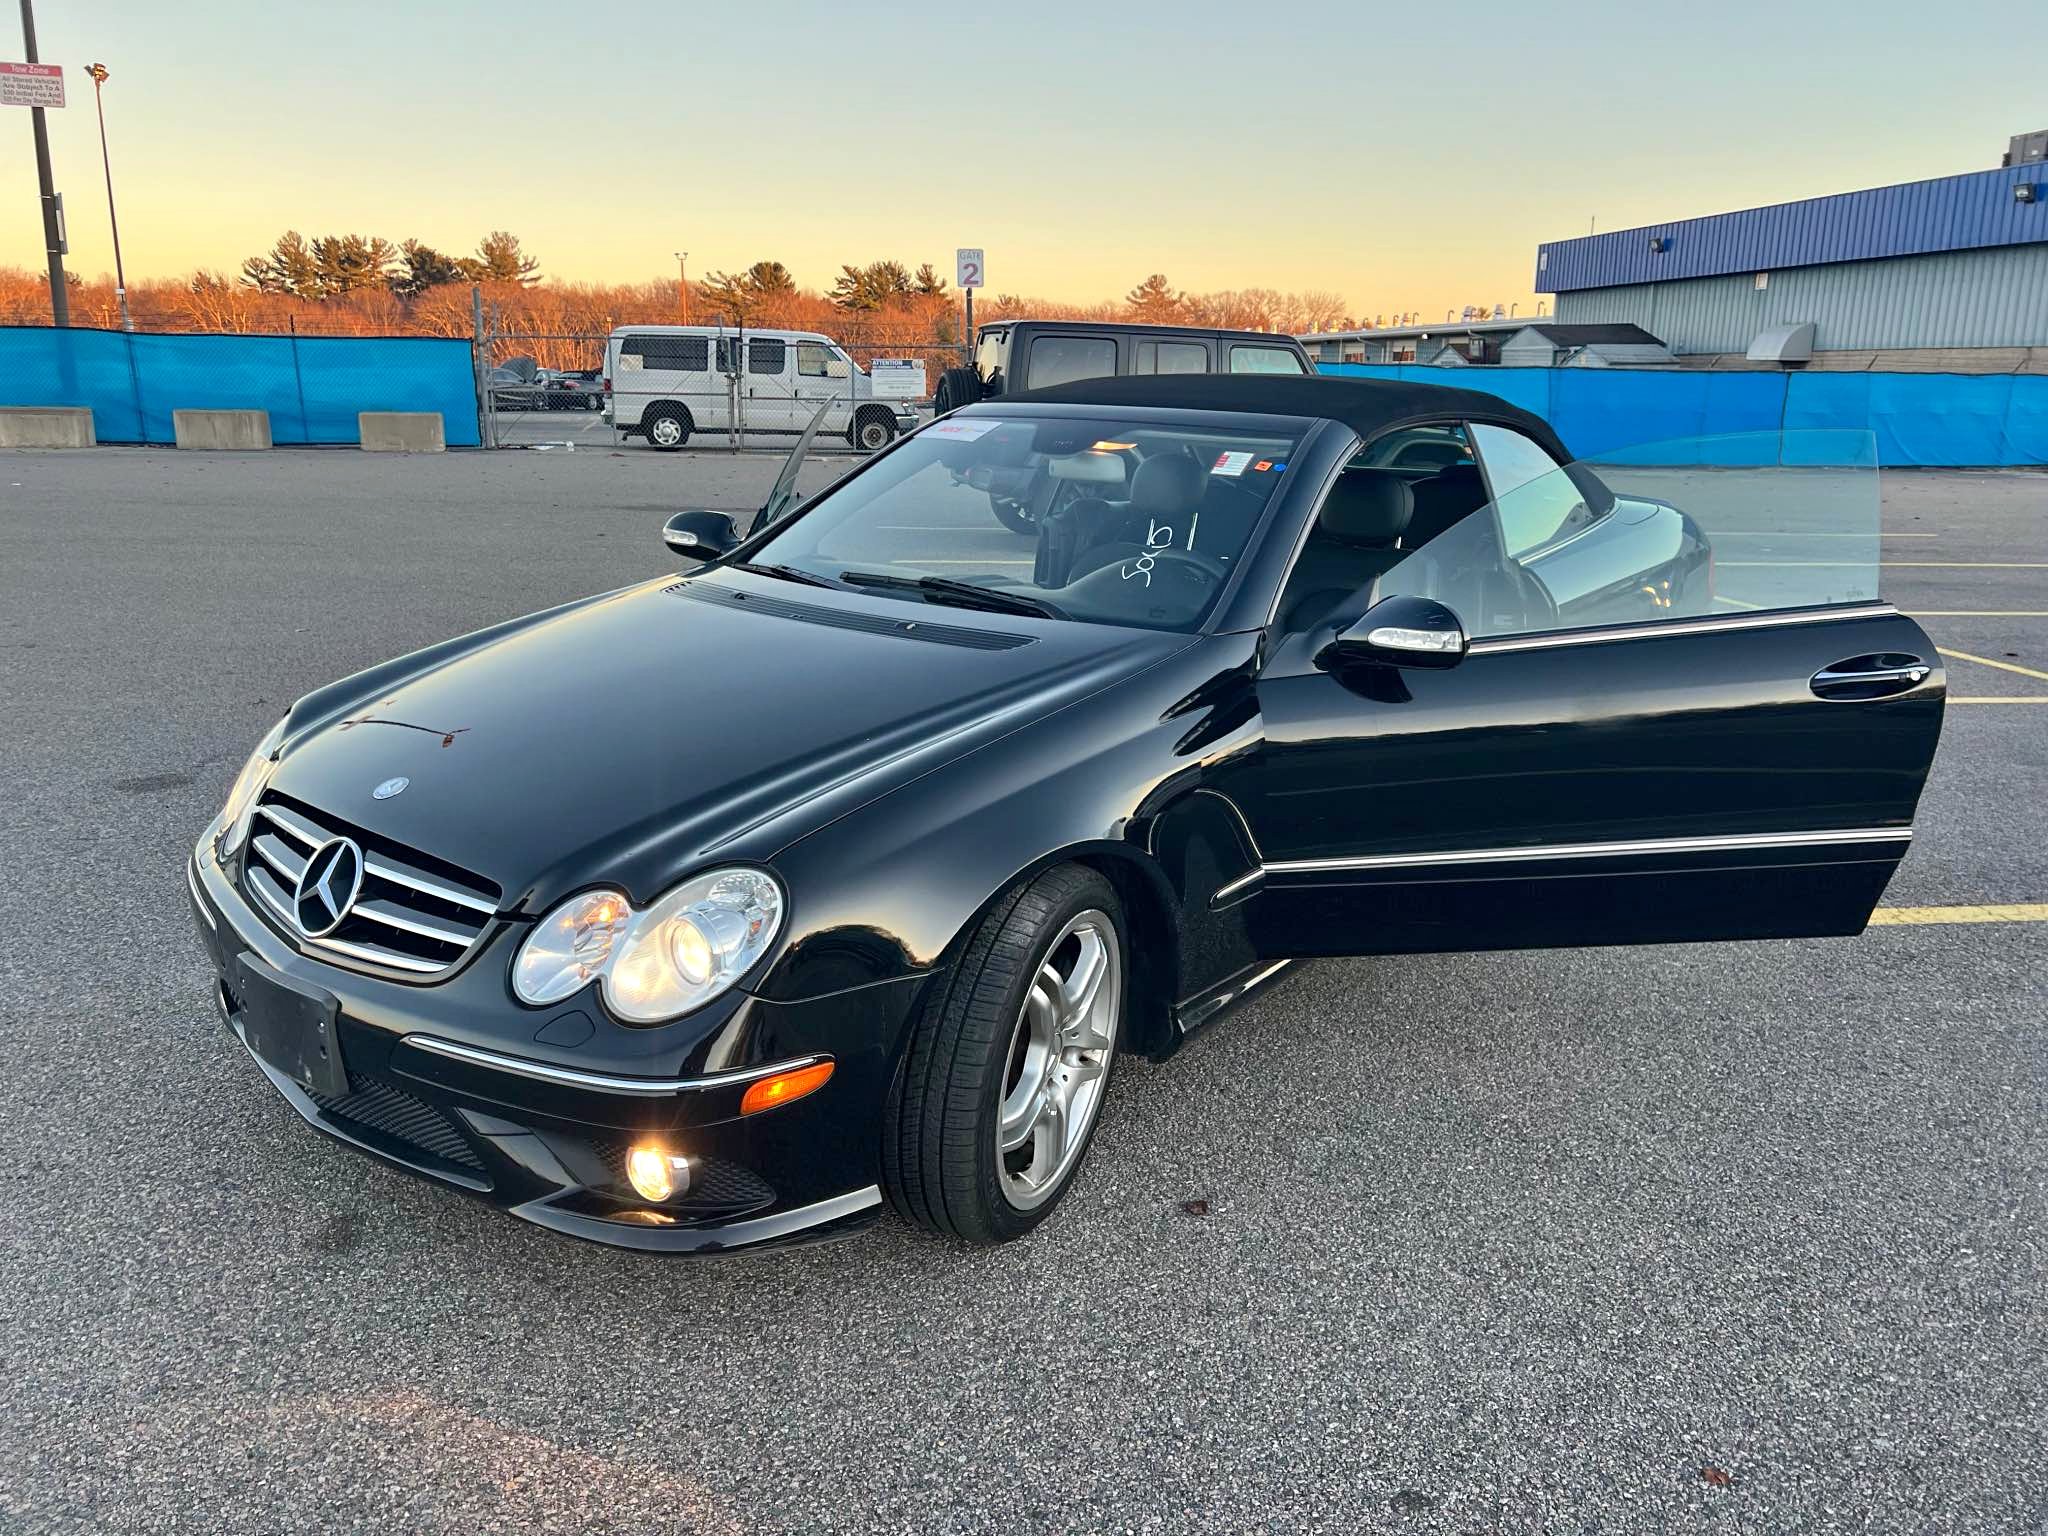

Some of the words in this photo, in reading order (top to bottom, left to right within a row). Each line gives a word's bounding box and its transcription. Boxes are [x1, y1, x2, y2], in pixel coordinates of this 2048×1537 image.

[11, 64, 28, 72] Tow
[29, 65, 49, 74] Zone
[16, 83, 43, 91] Subject
[960, 251, 980, 260] GATE
[963, 262, 979, 285] 2
